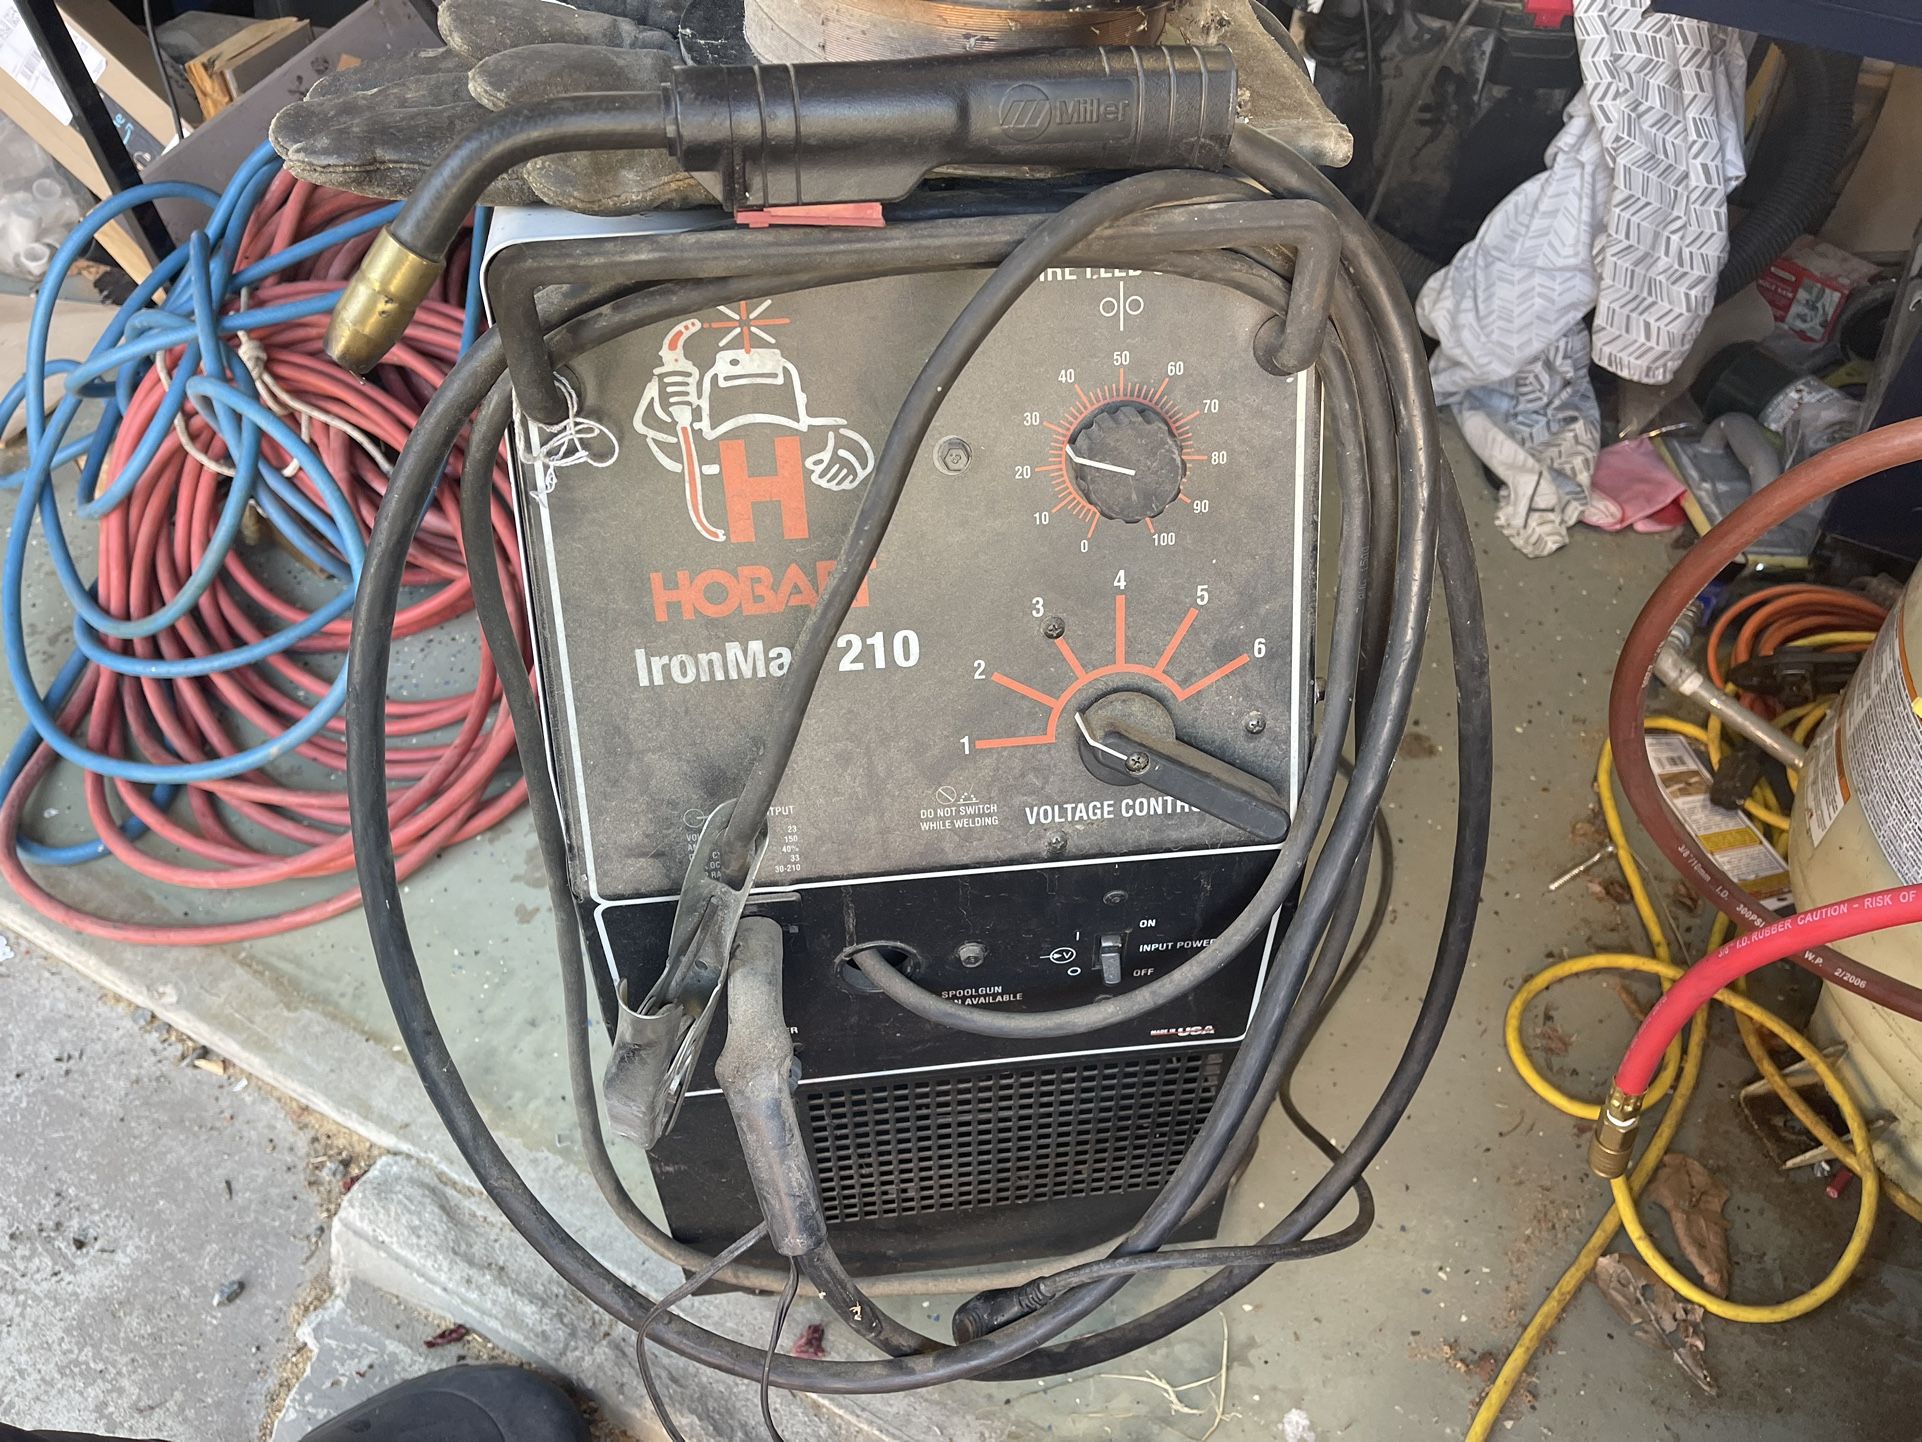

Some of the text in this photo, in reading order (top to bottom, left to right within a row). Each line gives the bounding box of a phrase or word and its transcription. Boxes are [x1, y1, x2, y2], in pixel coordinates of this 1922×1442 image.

[1056, 99, 1129, 125] Miller
[1040, 268, 1077, 281] IRE
[1113, 351, 1130, 365] 50
[1058, 369, 1075, 383] 40
[1167, 362, 1184, 376] 60
[1203, 400, 1219, 413] 70
[1023, 412, 1040, 426] 30
[1211, 451, 1227, 465] 80
[1015, 466, 1031, 479] 20
[1193, 500, 1209, 513] 90
[1033, 512, 1049, 525] 10
[1080, 540, 1088, 552] 0
[1152, 532, 1176, 546] 100
[1113, 570, 1126, 589] 4
[1196, 585, 1209, 605] 5
[1031, 597, 1044, 618] 3
[1253, 638, 1266, 658] 6
[634, 629, 920, 686] IronMa 210
[973, 660, 986, 679] 2
[960, 736, 970, 755] 1
[767, 806, 796, 816] TPUT
[920, 804, 997, 818] DO NOT SWITCH
[1025, 796, 1200, 825] VOLTAGE CONTR
[787, 825, 797, 833] 23
[920, 816, 999, 831] WHILE WELDING
[784, 835, 798, 843] 150
[774, 864, 801, 873] 30-210
[1139, 919, 1156, 928] ON
[1736, 937, 1750, 949] I.D.
[1752, 919, 1792, 943] RUBBER
[1797, 903, 1848, 926] CAUTION
[1864, 894, 1892, 909] RISK
[1900, 891, 1917, 903] OF
[1715, 885, 1729, 900] I.D.
[1736, 904, 1766, 928] 300PSI
[1804, 951, 1823, 967] W.P.
[1834, 968, 1867, 989] 2/2006
[1139, 942, 1174, 953] INPUT
[1133, 968, 1155, 977] OFF
[941, 986, 1002, 999] SPOOLGUN
[965, 993, 1023, 1005] AVAILABLE
[1177, 1025, 1215, 1037] USA
